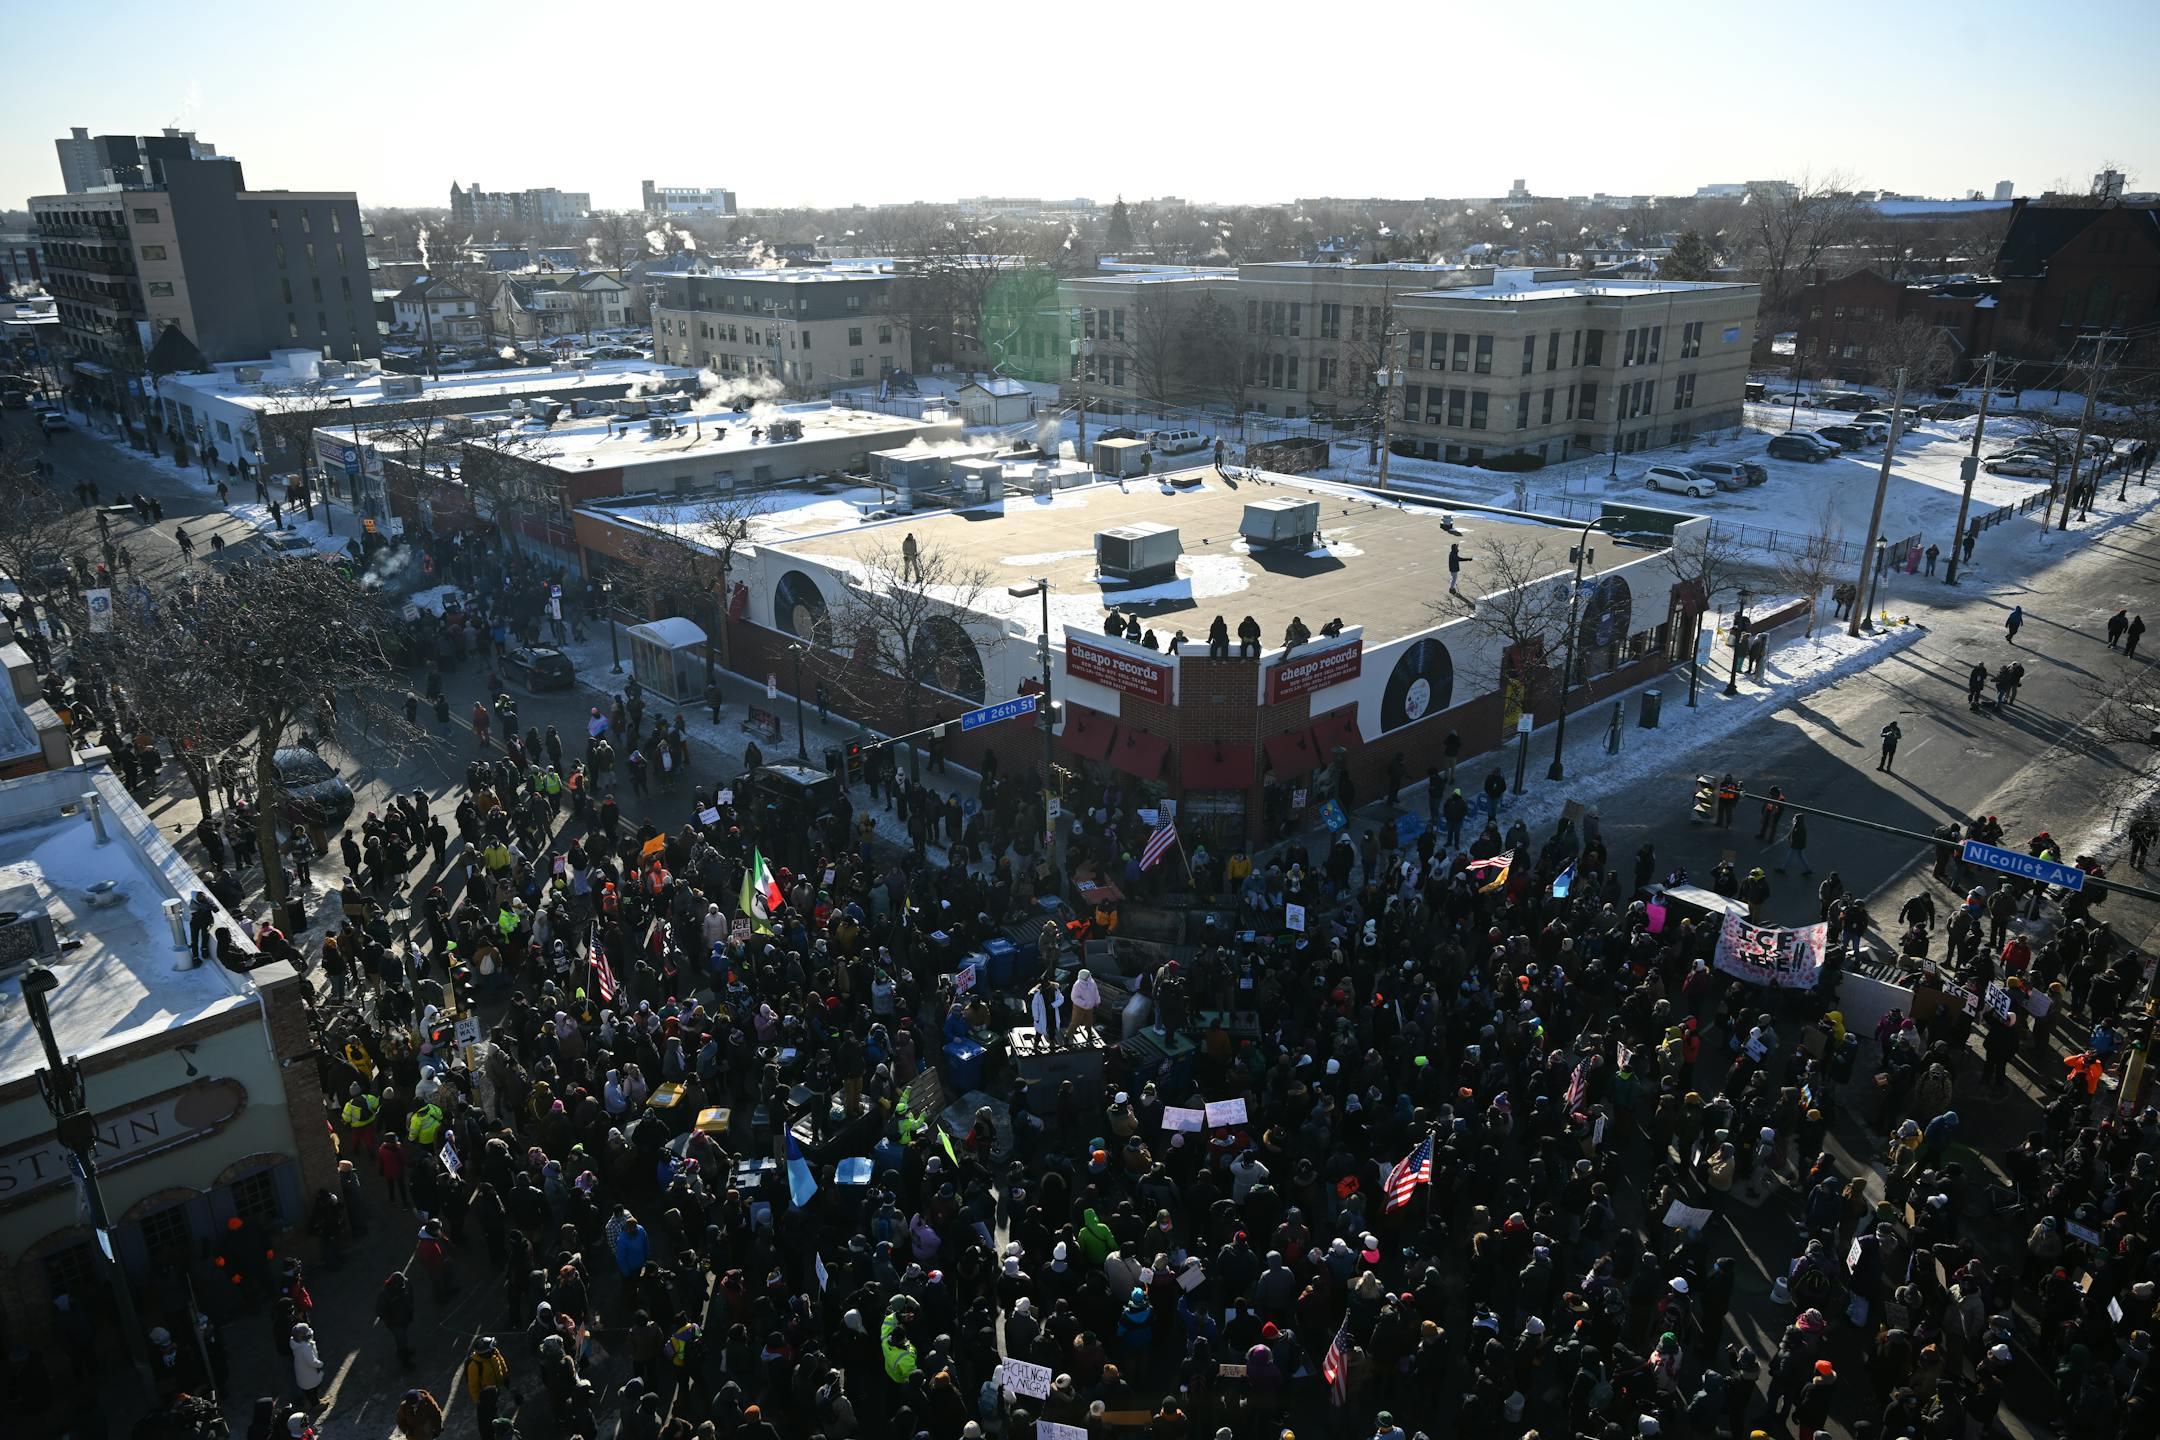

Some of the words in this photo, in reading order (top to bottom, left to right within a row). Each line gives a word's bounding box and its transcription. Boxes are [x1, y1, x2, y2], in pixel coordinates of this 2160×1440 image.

[1071, 646, 1111, 668] cheapo
[1112, 659, 1158, 681] records
[1281, 663, 1318, 682] cheapo
[1320, 647, 1358, 670] records
[977, 711, 986, 723] W
[991, 704, 1017, 719] 26th
[1021, 699, 1033, 710] St
[1969, 845, 2043, 876] Nicollet
[2050, 868, 2077, 884] Av
[1738, 922, 1795, 951] ICE
[1987, 992, 2007, 1016] ICE
[1989, 984, 2008, 1004] FUCK
[459, 1020, 474, 1030] ONE
[459, 1027, 475, 1036] WAY
[1002, 1360, 1050, 1383] #CHINGA
[1016, 1378, 1048, 1395] MIGRA
